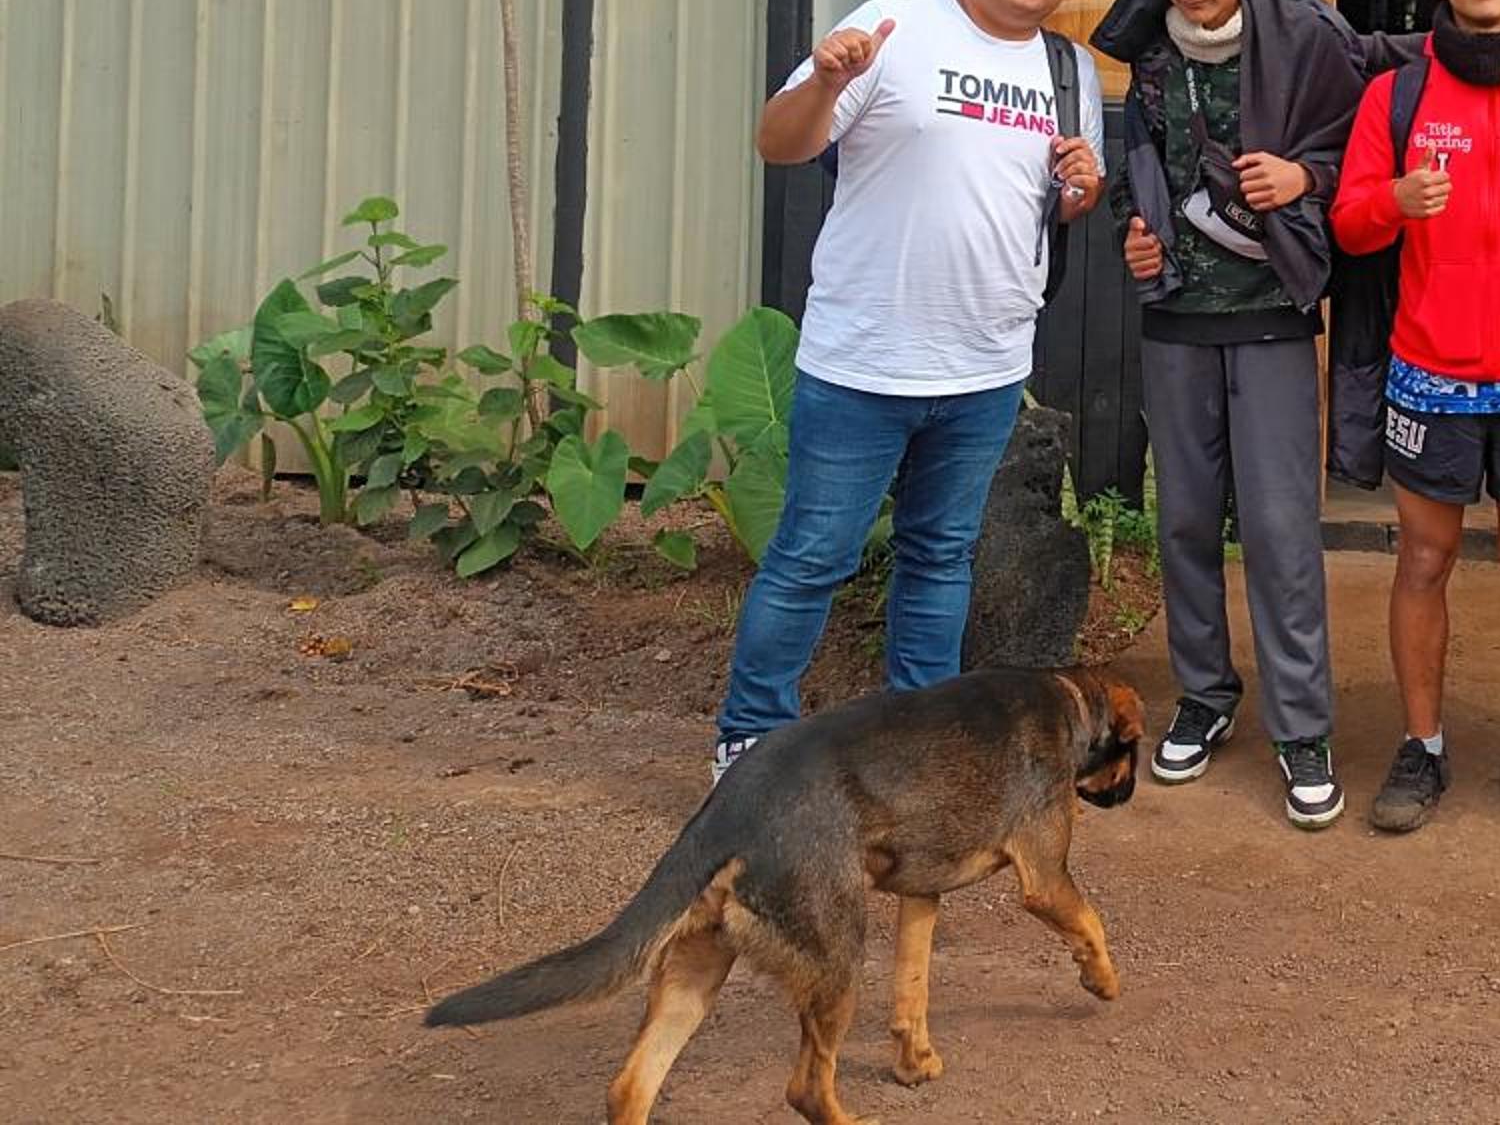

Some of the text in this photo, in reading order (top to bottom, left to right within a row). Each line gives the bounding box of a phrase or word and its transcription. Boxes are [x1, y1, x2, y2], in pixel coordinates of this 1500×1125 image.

[938, 68, 1055, 116] TOMMY
[986, 106, 1056, 137] JEANS
[1424, 122, 1463, 136] Title
[1413, 132, 1473, 154] Boxing
[1385, 405, 1428, 454] ESU
